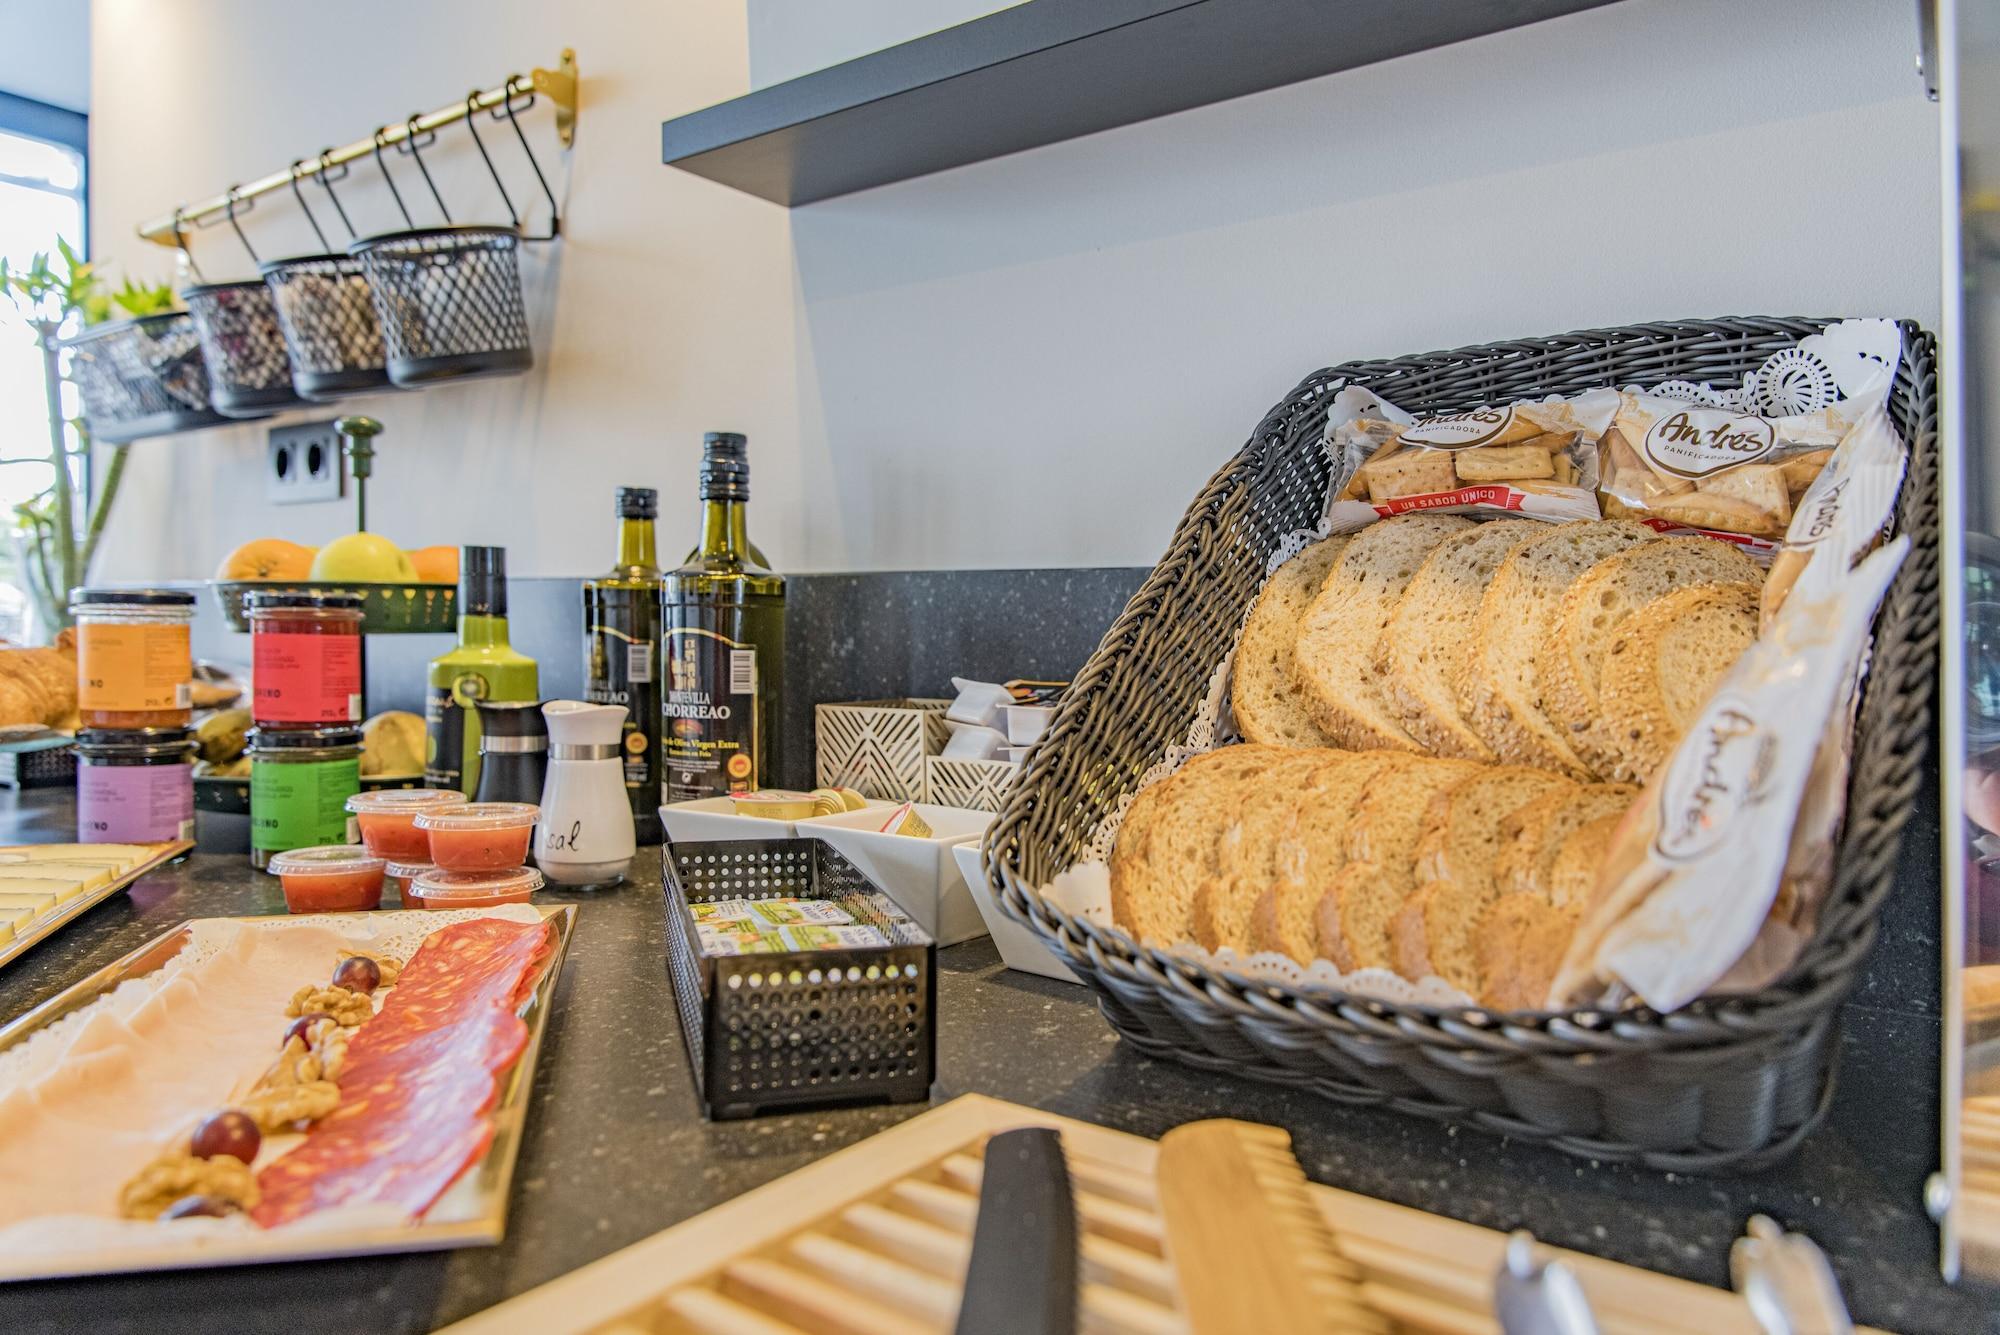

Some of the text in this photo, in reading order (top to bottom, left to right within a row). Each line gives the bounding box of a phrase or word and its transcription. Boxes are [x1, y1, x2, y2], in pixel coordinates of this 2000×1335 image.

[1414, 425, 1481, 435] PANIFICADORA
[1663, 444, 1737, 461] PANIFICADORA
[1400, 488, 1496, 510] UN SABOR ÚNICO
[718, 740, 740, 750] Extra
[546, 820, 581, 852] sal
